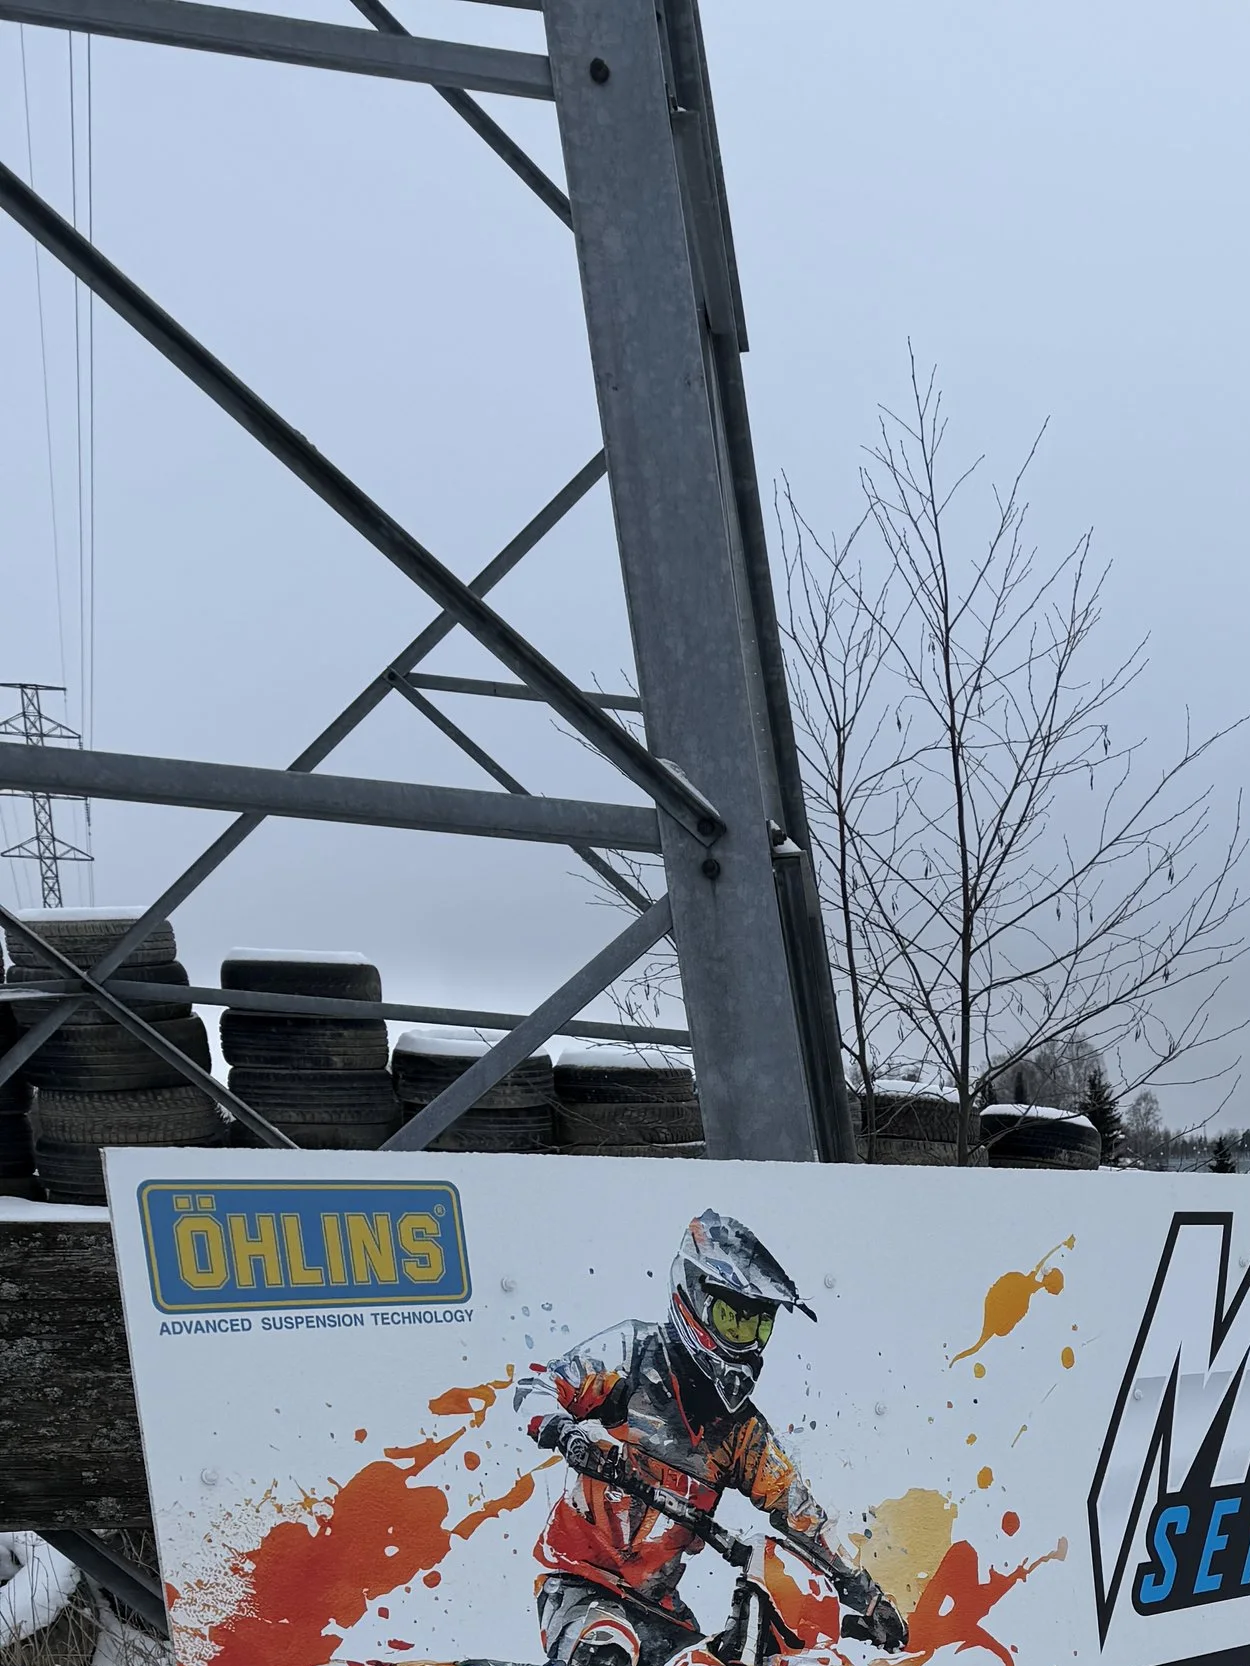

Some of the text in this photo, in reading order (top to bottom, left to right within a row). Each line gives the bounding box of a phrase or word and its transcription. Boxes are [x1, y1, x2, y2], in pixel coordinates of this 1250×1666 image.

[159, 1308, 475, 1336] ADVANCED SUSPENSION TECHNOLOGY
